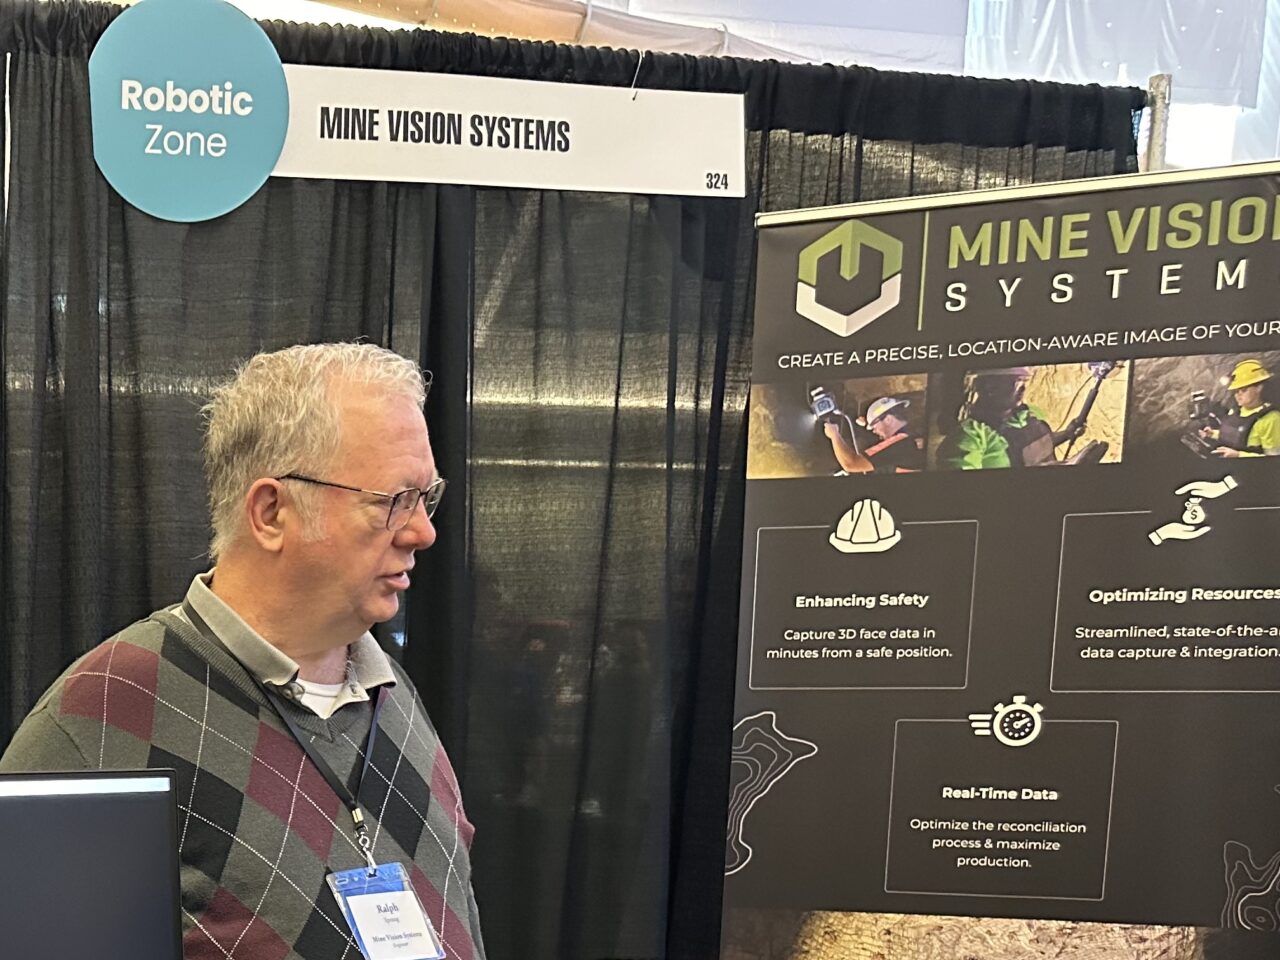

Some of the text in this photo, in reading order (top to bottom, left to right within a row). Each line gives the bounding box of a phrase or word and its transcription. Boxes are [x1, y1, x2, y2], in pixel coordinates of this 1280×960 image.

[120, 79, 254, 118] Robotic
[320, 106, 571, 153] MINE VISION SYSTEMS
[144, 124, 228, 157] Zone
[705, 173, 729, 191] 324
[948, 212, 1091, 269] MINE
[777, 319, 1280, 369] CREATE A PRECISE, LOCATION-AWARE IMAGE OF YOUR
[795, 592, 929, 609] Enhancing Safety
[1088, 587, 1280, 605] Optimizing Resources
[783, 627, 936, 643] Capture 3D face data in
[1075, 624, 1280, 639] Streamlined, state-of-the-a
[766, 646, 953, 660] minutes from a safe position.
[1080, 646, 1280, 660] data capture & integration.
[942, 787, 1058, 801] Real-Time Data
[910, 818, 1087, 833] Optimize the reconciliation
[932, 839, 1060, 851] process & maximize
[956, 856, 1032, 868] production.
[376, 903, 399, 914] Ralph
